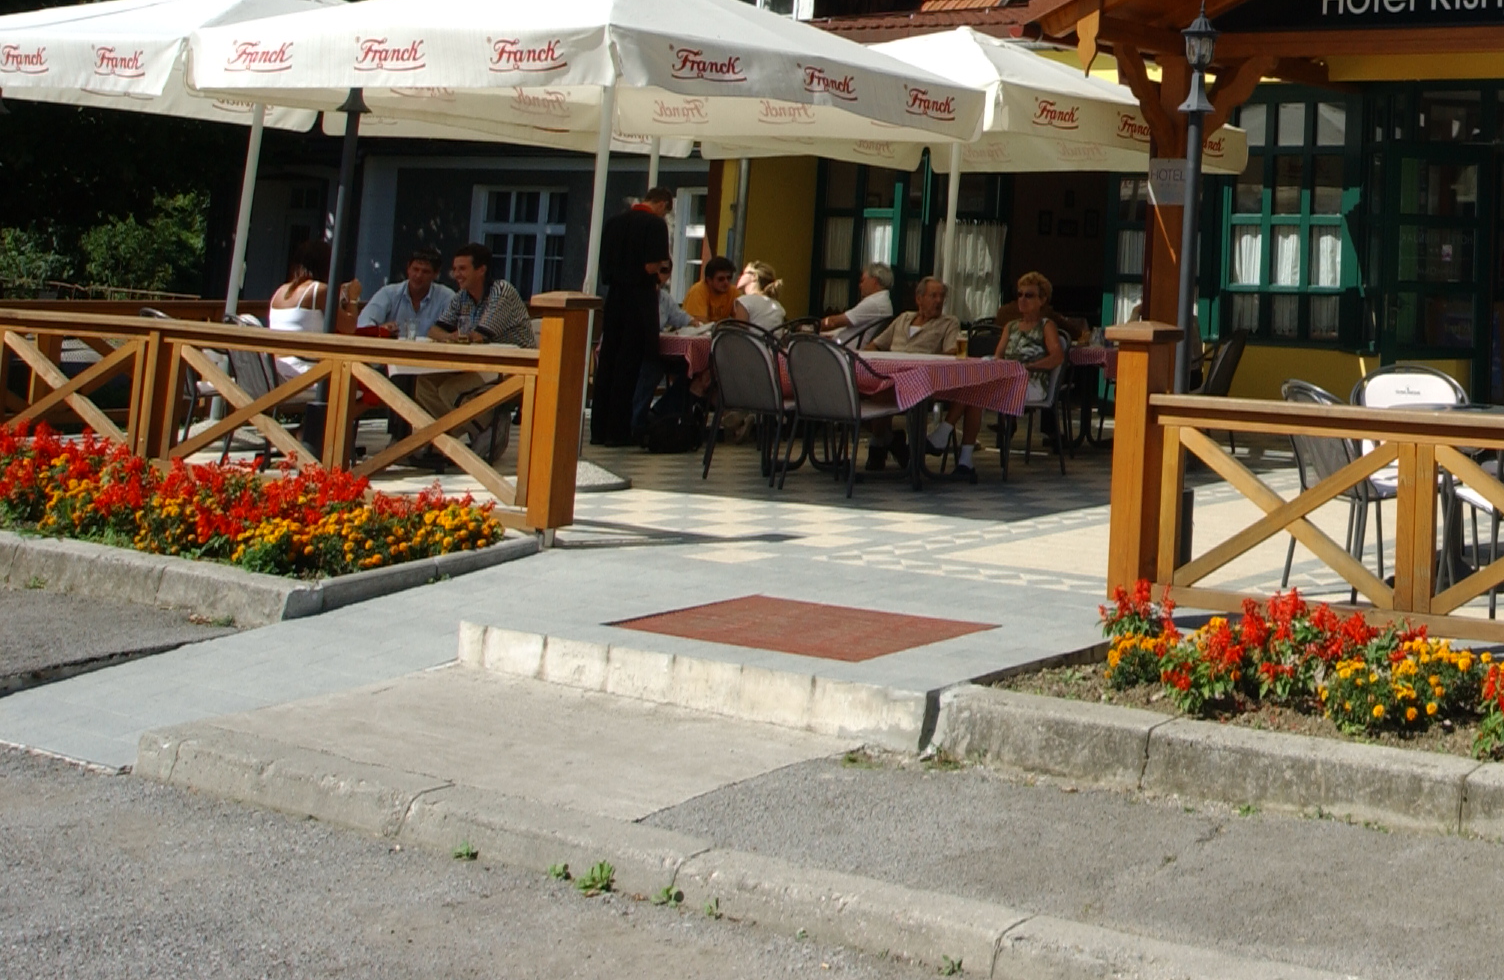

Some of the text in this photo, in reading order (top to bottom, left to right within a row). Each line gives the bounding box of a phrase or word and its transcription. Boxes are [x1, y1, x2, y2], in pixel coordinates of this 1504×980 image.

[1, 45, 48, 67] Franck
[95, 47, 144, 70] Franck
[227, 40, 294, 64] Franck
[356, 37, 425, 63] Franck
[490, 38, 564, 64] Franck
[672, 49, 743, 76] Franck
[804, 66, 856, 94] Franck
[906, 88, 956, 115] Franck
[1034, 100, 1079, 124] Franck
[1118, 113, 1150, 137] Franc
[1203, 137, 1225, 152] anck
[1150, 168, 1186, 182] HOTEL
